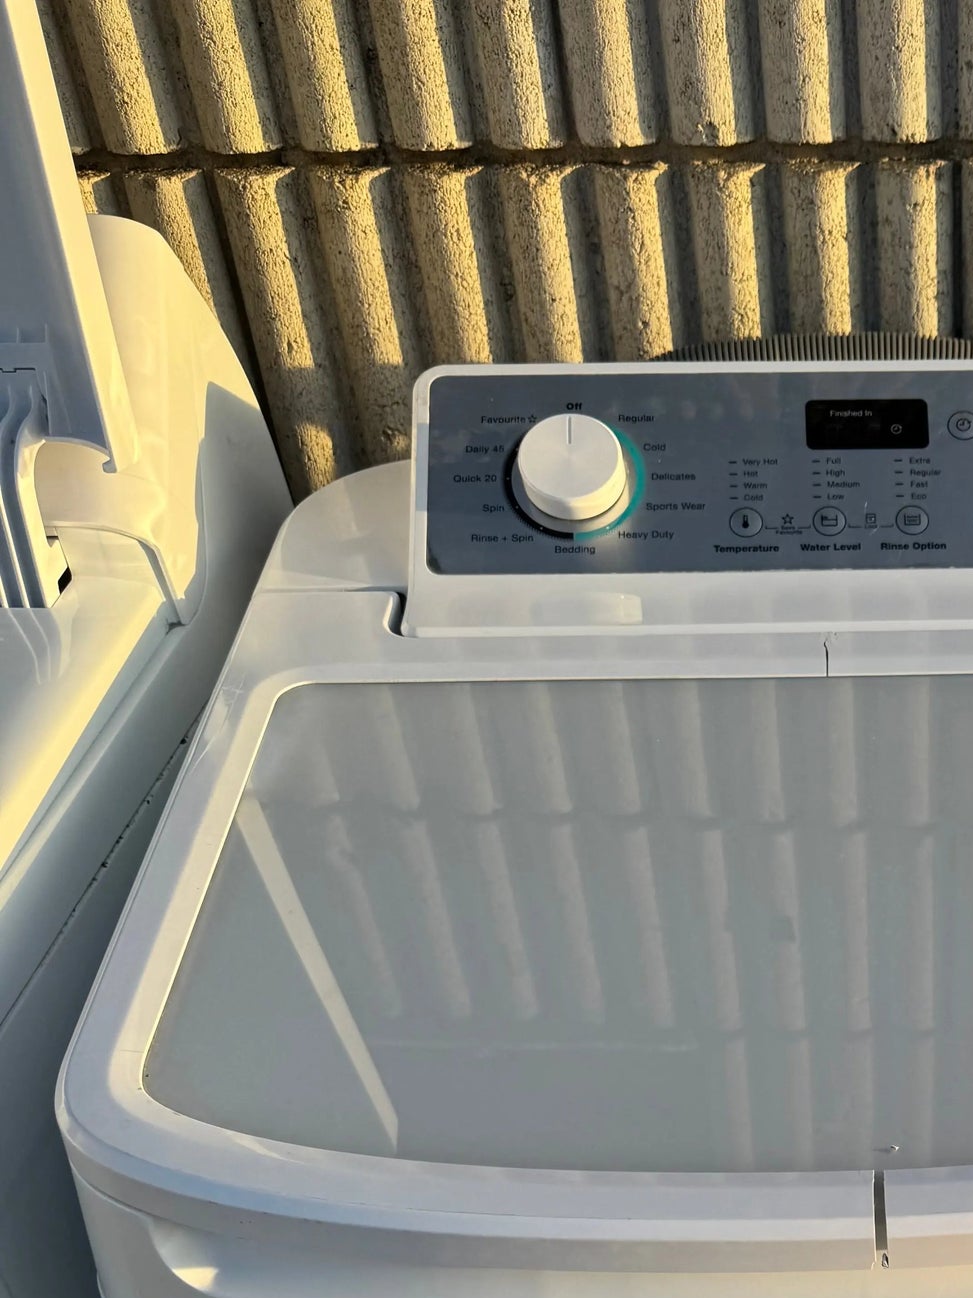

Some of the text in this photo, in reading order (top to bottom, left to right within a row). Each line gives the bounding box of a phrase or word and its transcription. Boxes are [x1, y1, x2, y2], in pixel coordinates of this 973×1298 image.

[566, 403, 583, 411] Off
[481, 415, 525, 424] Favourite
[618, 414, 655, 423] Regular
[465, 445, 490, 454] Daily
[643, 443, 666, 451] Cold
[742, 458, 761, 467] Very
[825, 469, 846, 477] High
[910, 469, 941, 477] Regular
[453, 475, 482, 483] Quick
[482, 504, 505, 513] Spin
[646, 503, 678, 511] Sports
[471, 534, 500, 542] Rinse
[511, 534, 534, 543] Spin
[618, 530, 674, 540] Heavy Duty
[555, 546, 595, 555] Bedding
[713, 544, 780, 554] Temperature
[800, 543, 861, 552] Water Level
[880, 542, 947, 551] Rinse Option
